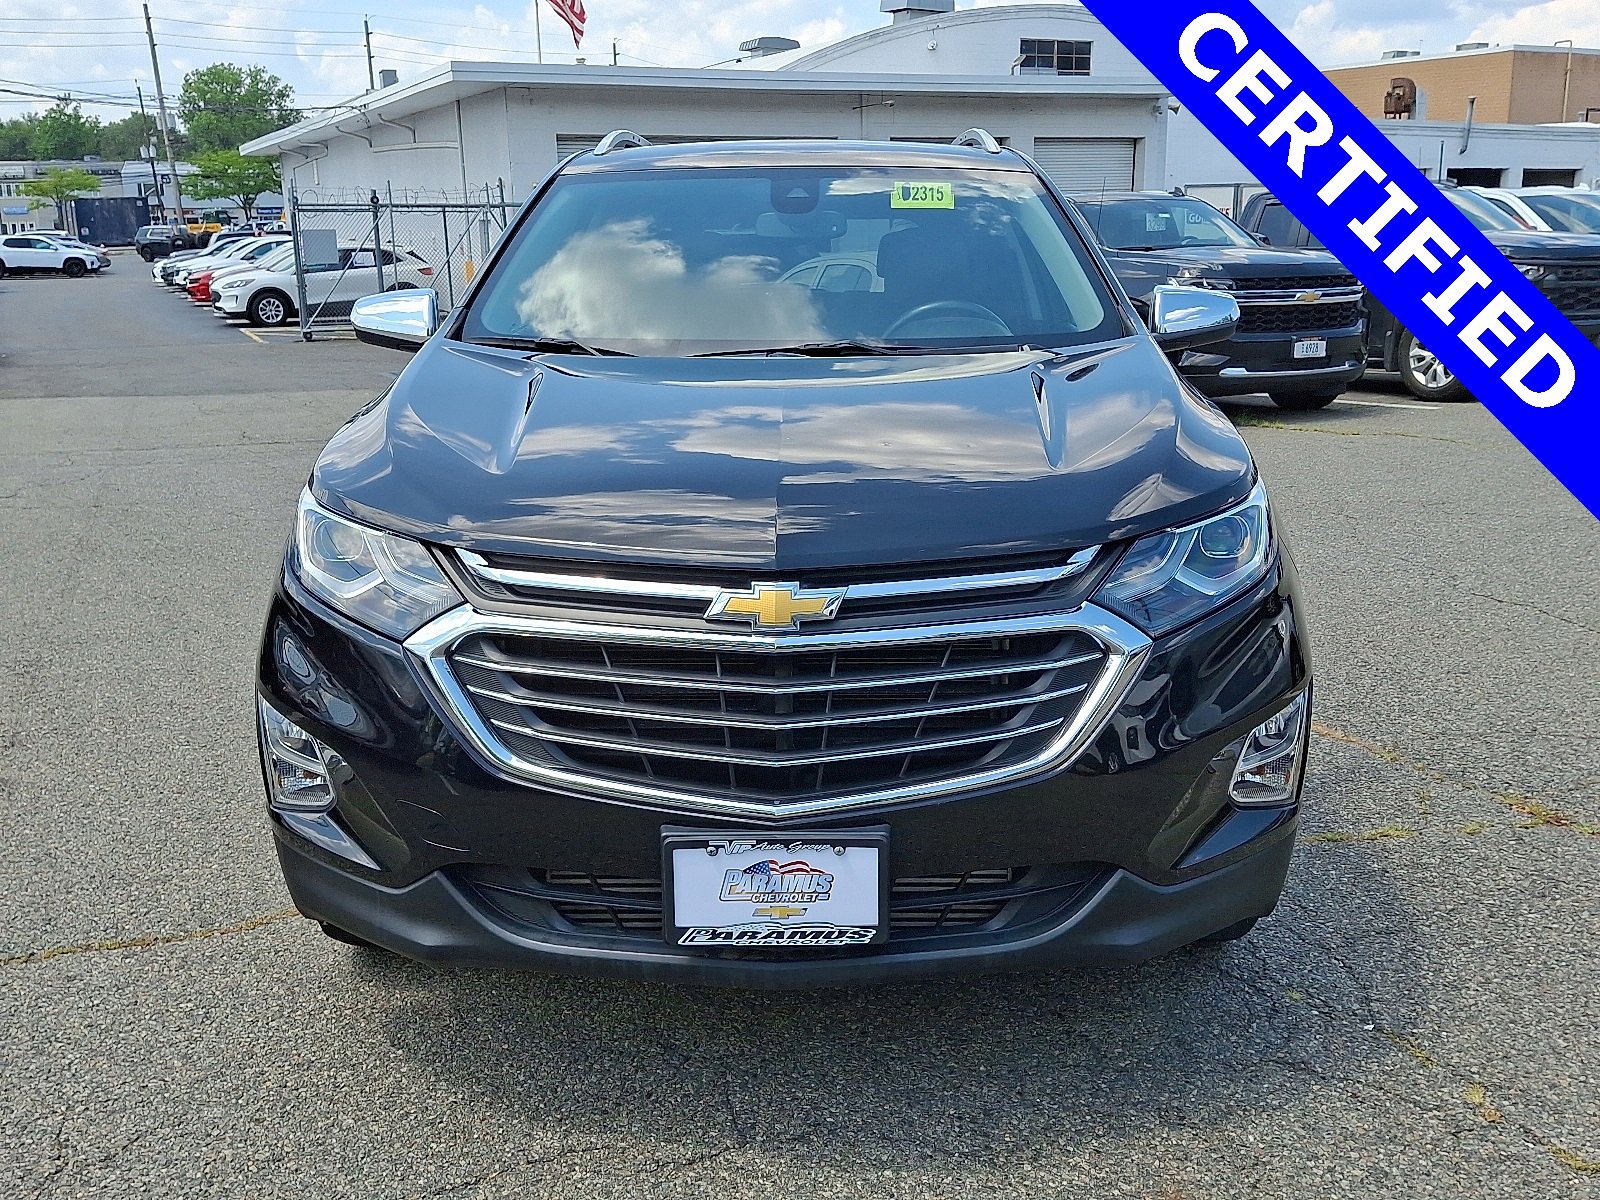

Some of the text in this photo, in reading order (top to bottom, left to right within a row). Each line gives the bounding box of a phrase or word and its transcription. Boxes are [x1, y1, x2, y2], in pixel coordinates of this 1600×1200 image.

[709, 840, 831, 855] VIP Auto Group
[720, 869, 834, 896] PARAMUS
[751, 893, 819, 903] CHEVROLET
[680, 927, 876, 942] PARAMUS
